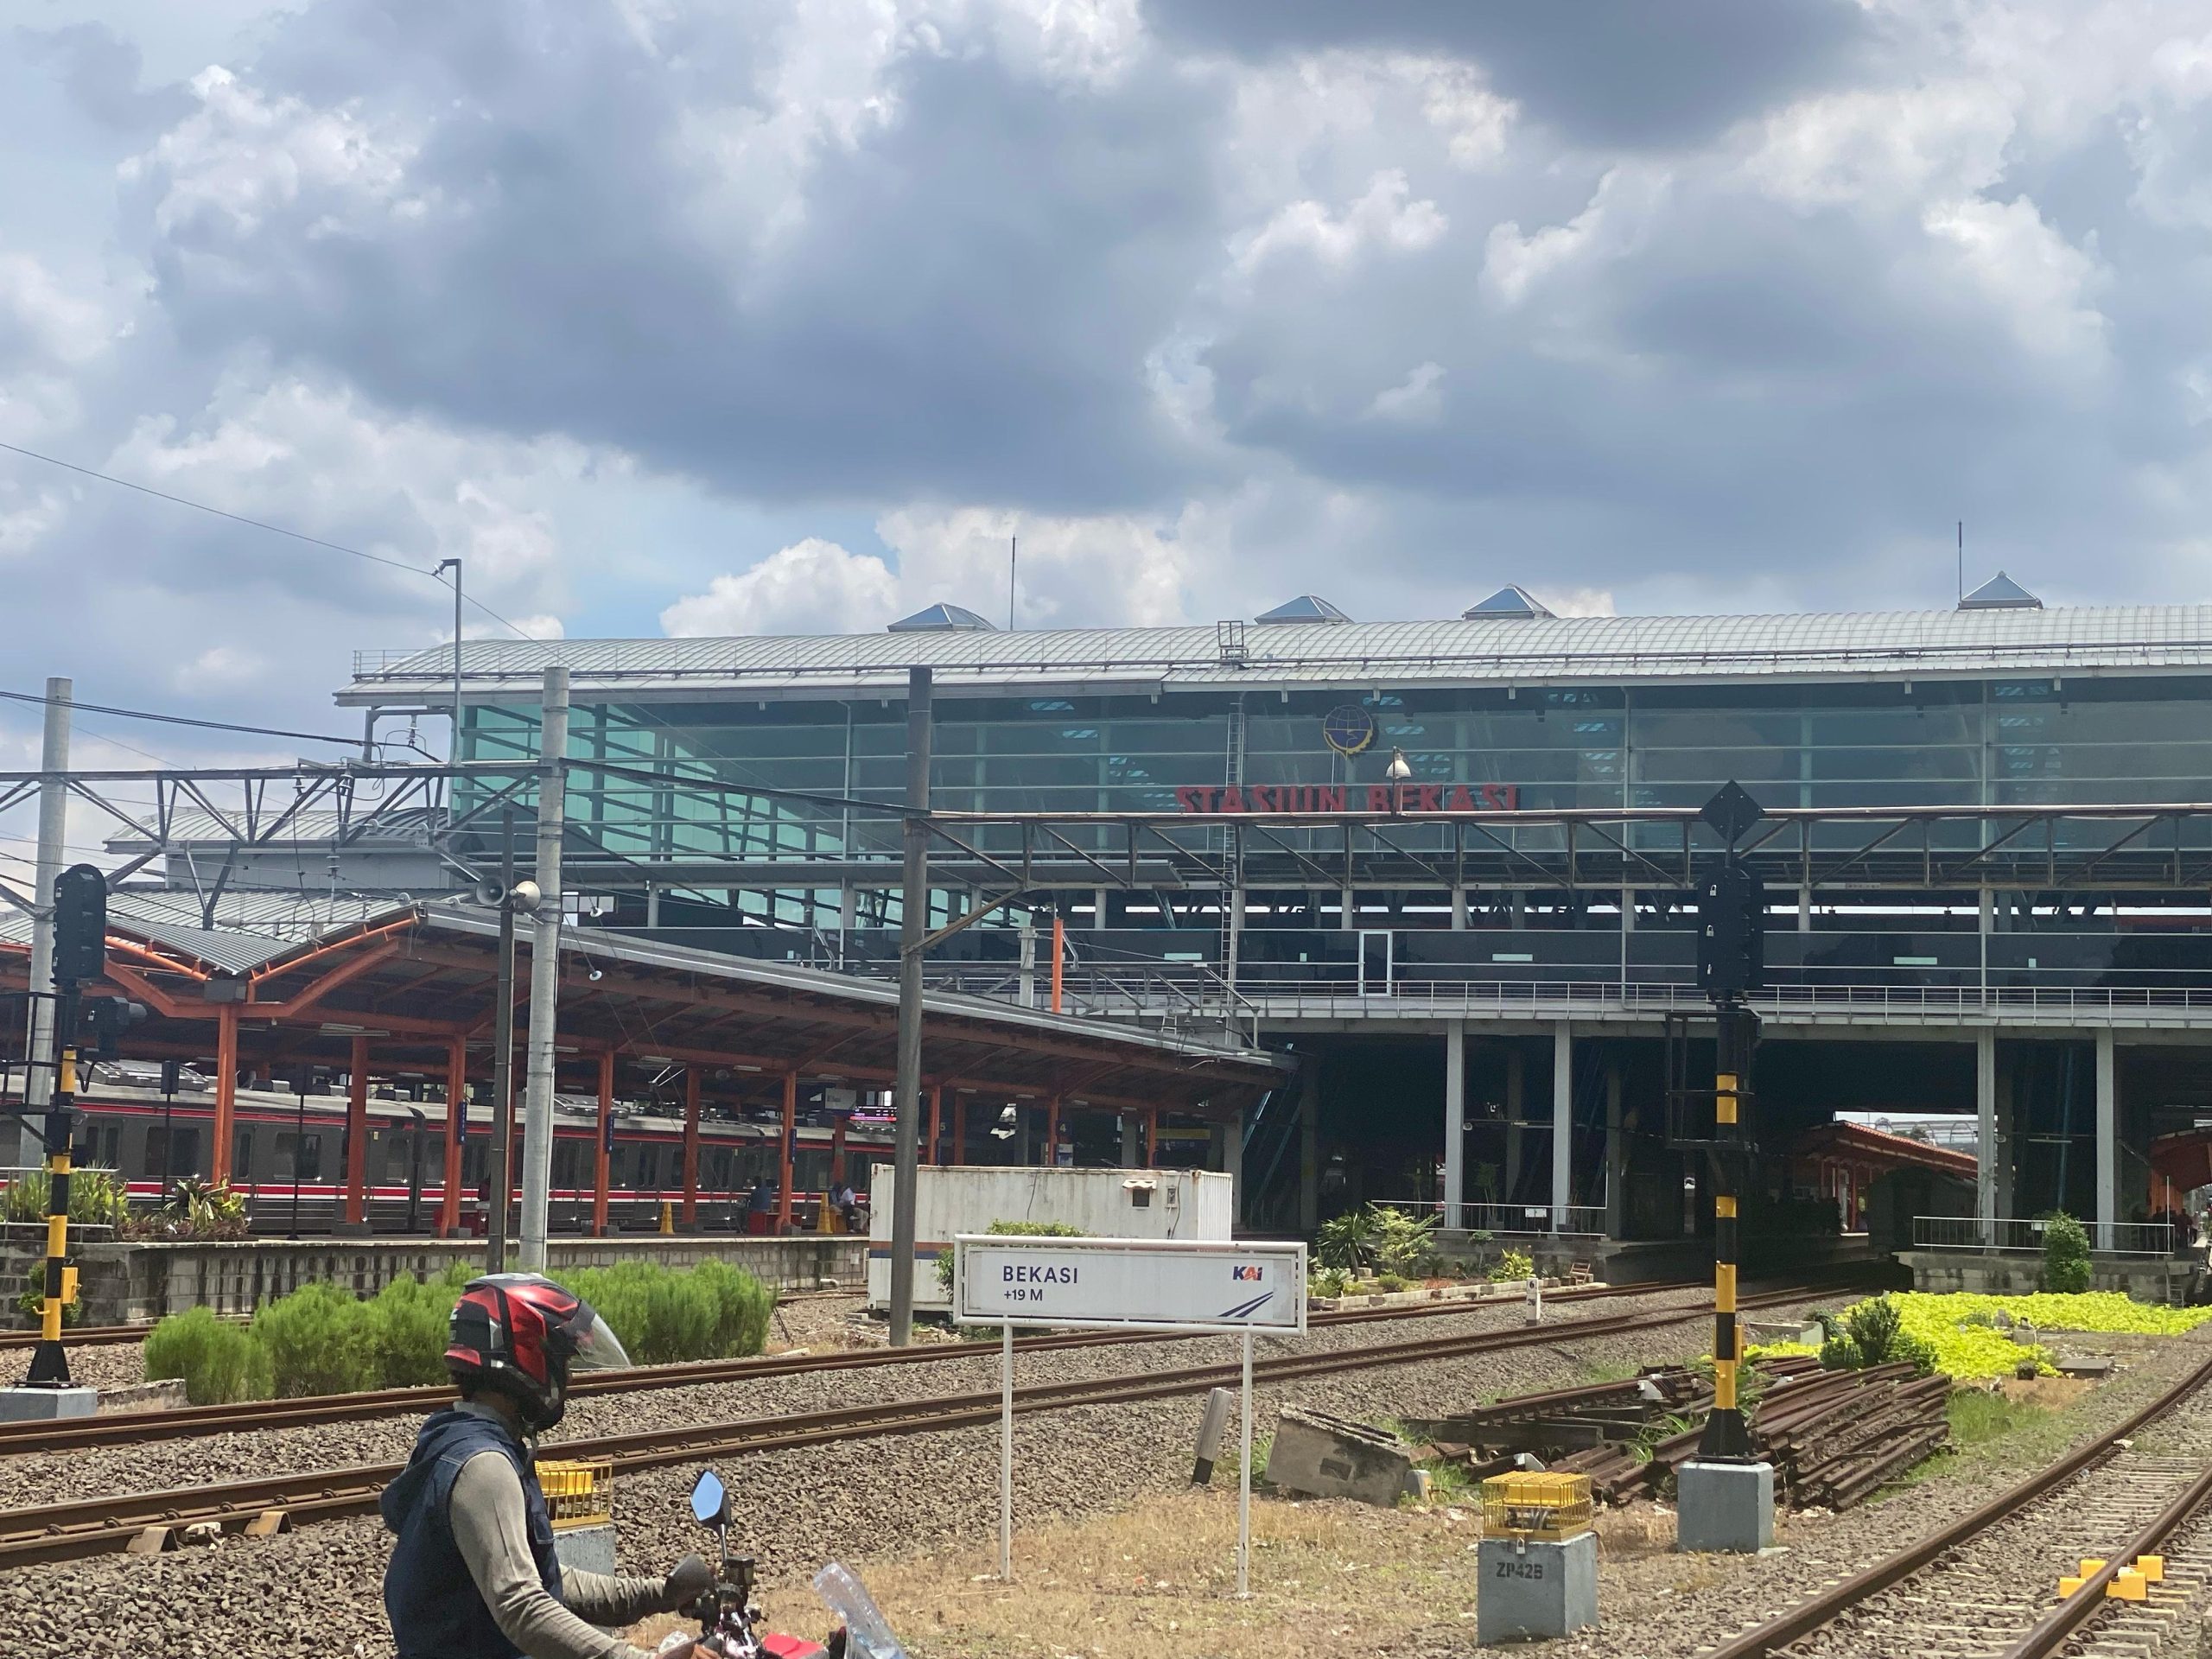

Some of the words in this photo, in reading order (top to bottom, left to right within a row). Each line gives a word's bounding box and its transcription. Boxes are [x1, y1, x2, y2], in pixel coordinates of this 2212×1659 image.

[1176, 785, 1345, 812] STASIUN
[1368, 784, 1516, 812] BEKASI
[1002, 1265, 1077, 1284] BEKASI
[1232, 1265, 1262, 1281] KAI
[1529, 1280, 1535, 1288] 6
[1003, 1288, 1026, 1300] +19
[1030, 1288, 1043, 1301] M
[1496, 1561, 1543, 1580] ZP42B
